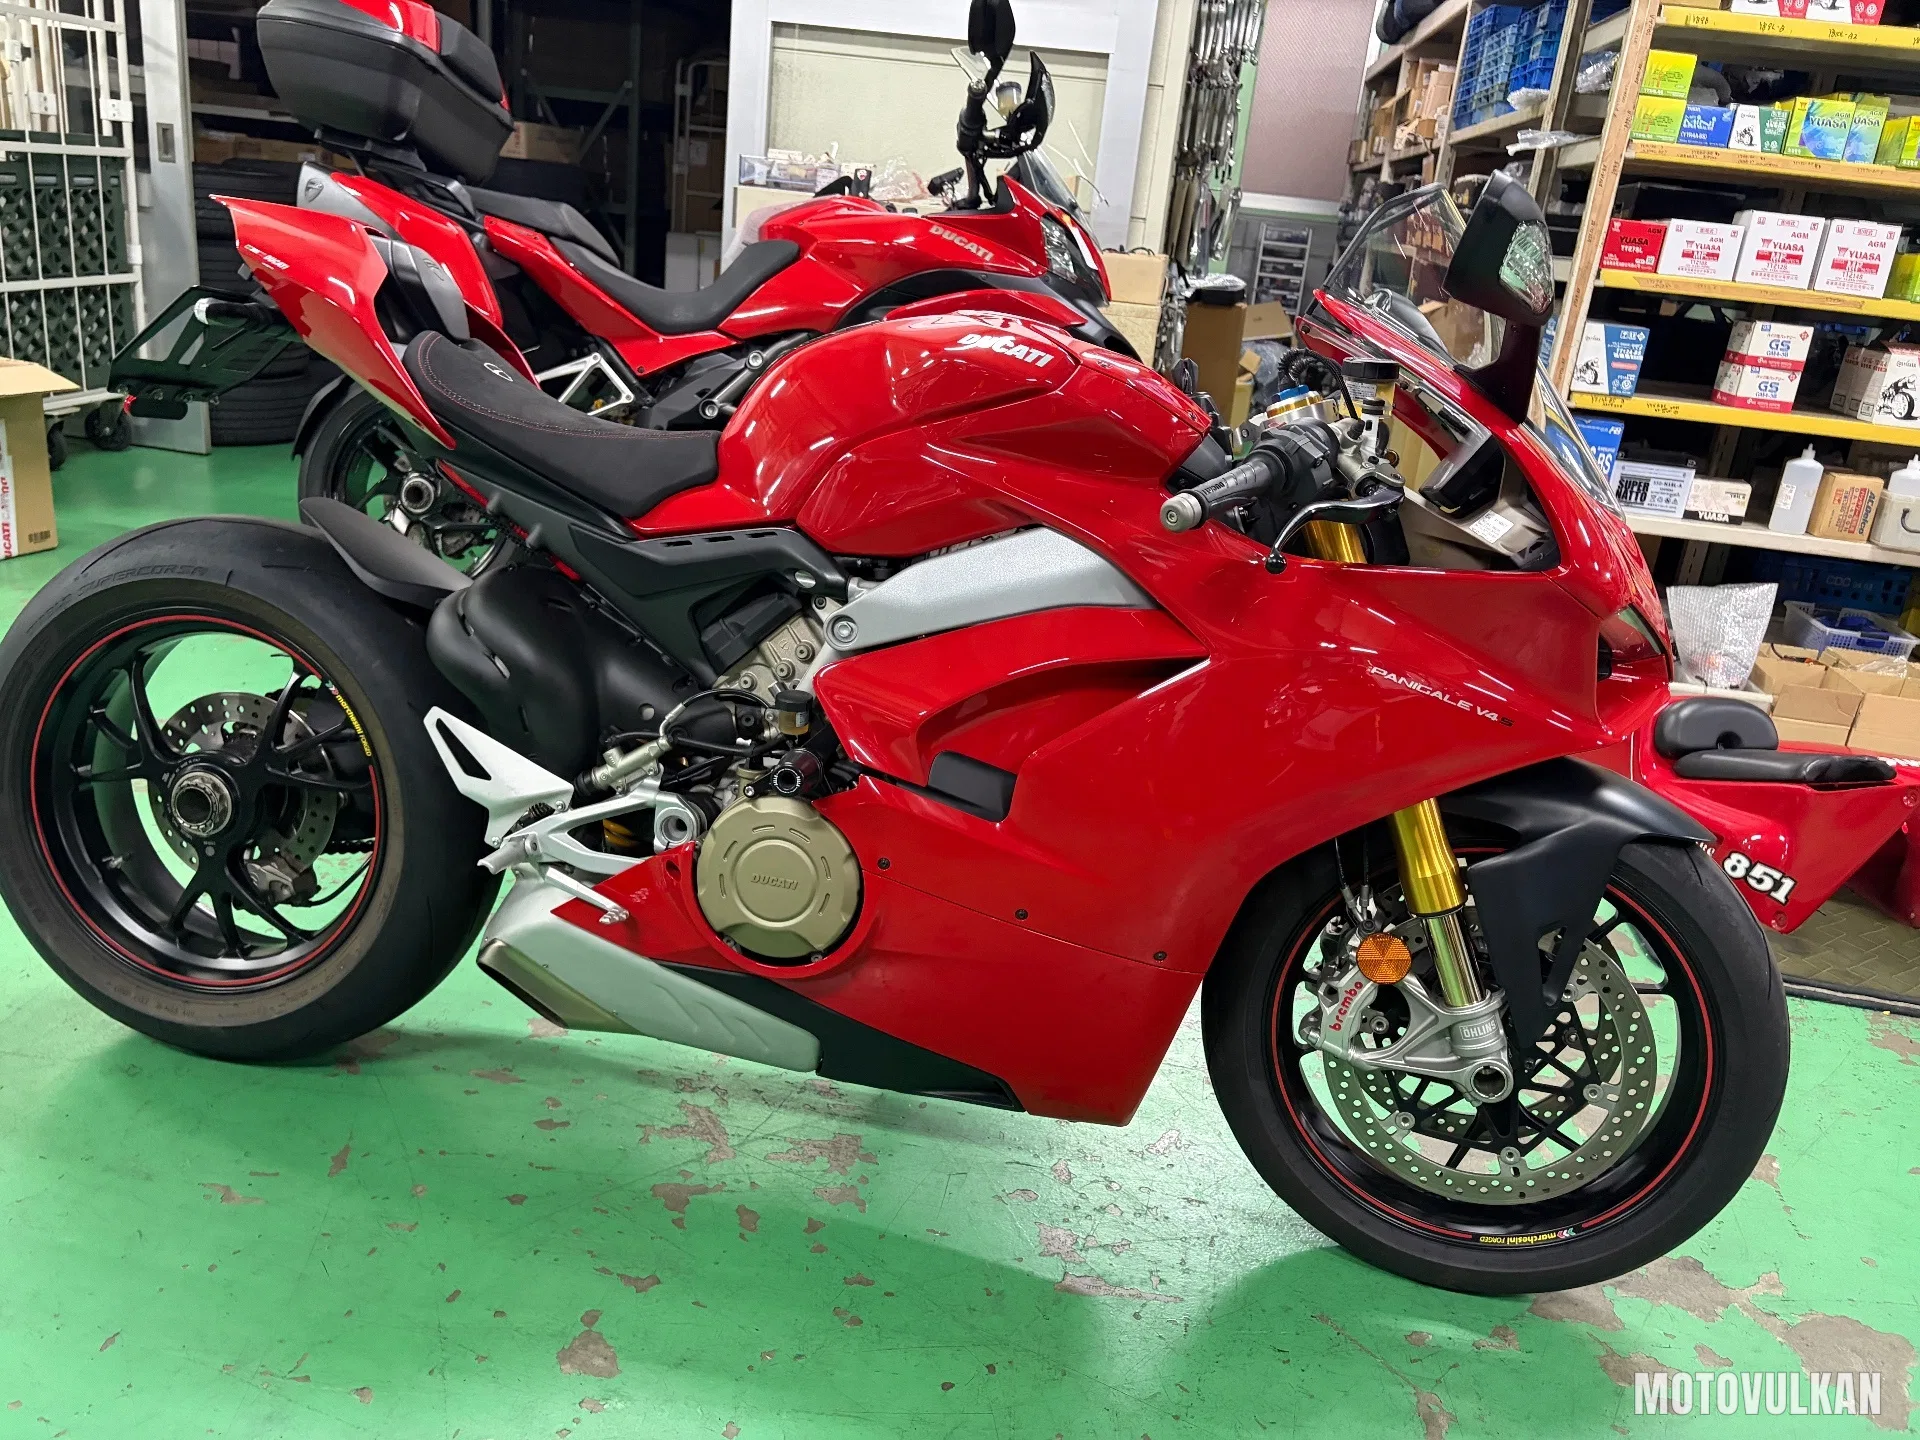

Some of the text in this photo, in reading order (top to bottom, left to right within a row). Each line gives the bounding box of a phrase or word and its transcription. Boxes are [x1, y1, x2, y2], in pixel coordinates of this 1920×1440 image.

[1809, 115, 1847, 130] YUASA
[1853, 117, 1880, 127] UASA
[1620, 235, 1649, 246] YUASA
[1709, 236, 1724, 244] AGM
[1790, 231, 1809, 240] AGM
[929, 225, 995, 262] DUCATI
[1695, 243, 1721, 252] YUASA
[1772, 241, 1805, 253] YUASA
[1867, 240, 1887, 249] AGM
[263, 254, 291, 270] DUCATI
[1849, 250, 1881, 262] YUASA
[956, 333, 1054, 367] DUCATI
[1768, 339, 1792, 352] GS
[1757, 381, 1779, 394] GS
[1618, 479, 1650, 492] SUPER
[1615, 489, 1647, 502] NATTO
[1697, 510, 1730, 523] YUASA
[1858, 489, 1876, 536] ACDelco
[1370, 666, 1515, 727] PANIGALE V4 S
[336, 693, 372, 757] marchesini FORGED
[750, 873, 799, 891] DUCATI
[1723, 852, 1796, 905] 851
[1328, 981, 1364, 1032] brembo
[1462, 1018, 1498, 1040] ÖHLINS
[1479, 1231, 1558, 1246] marchesini FORGED
